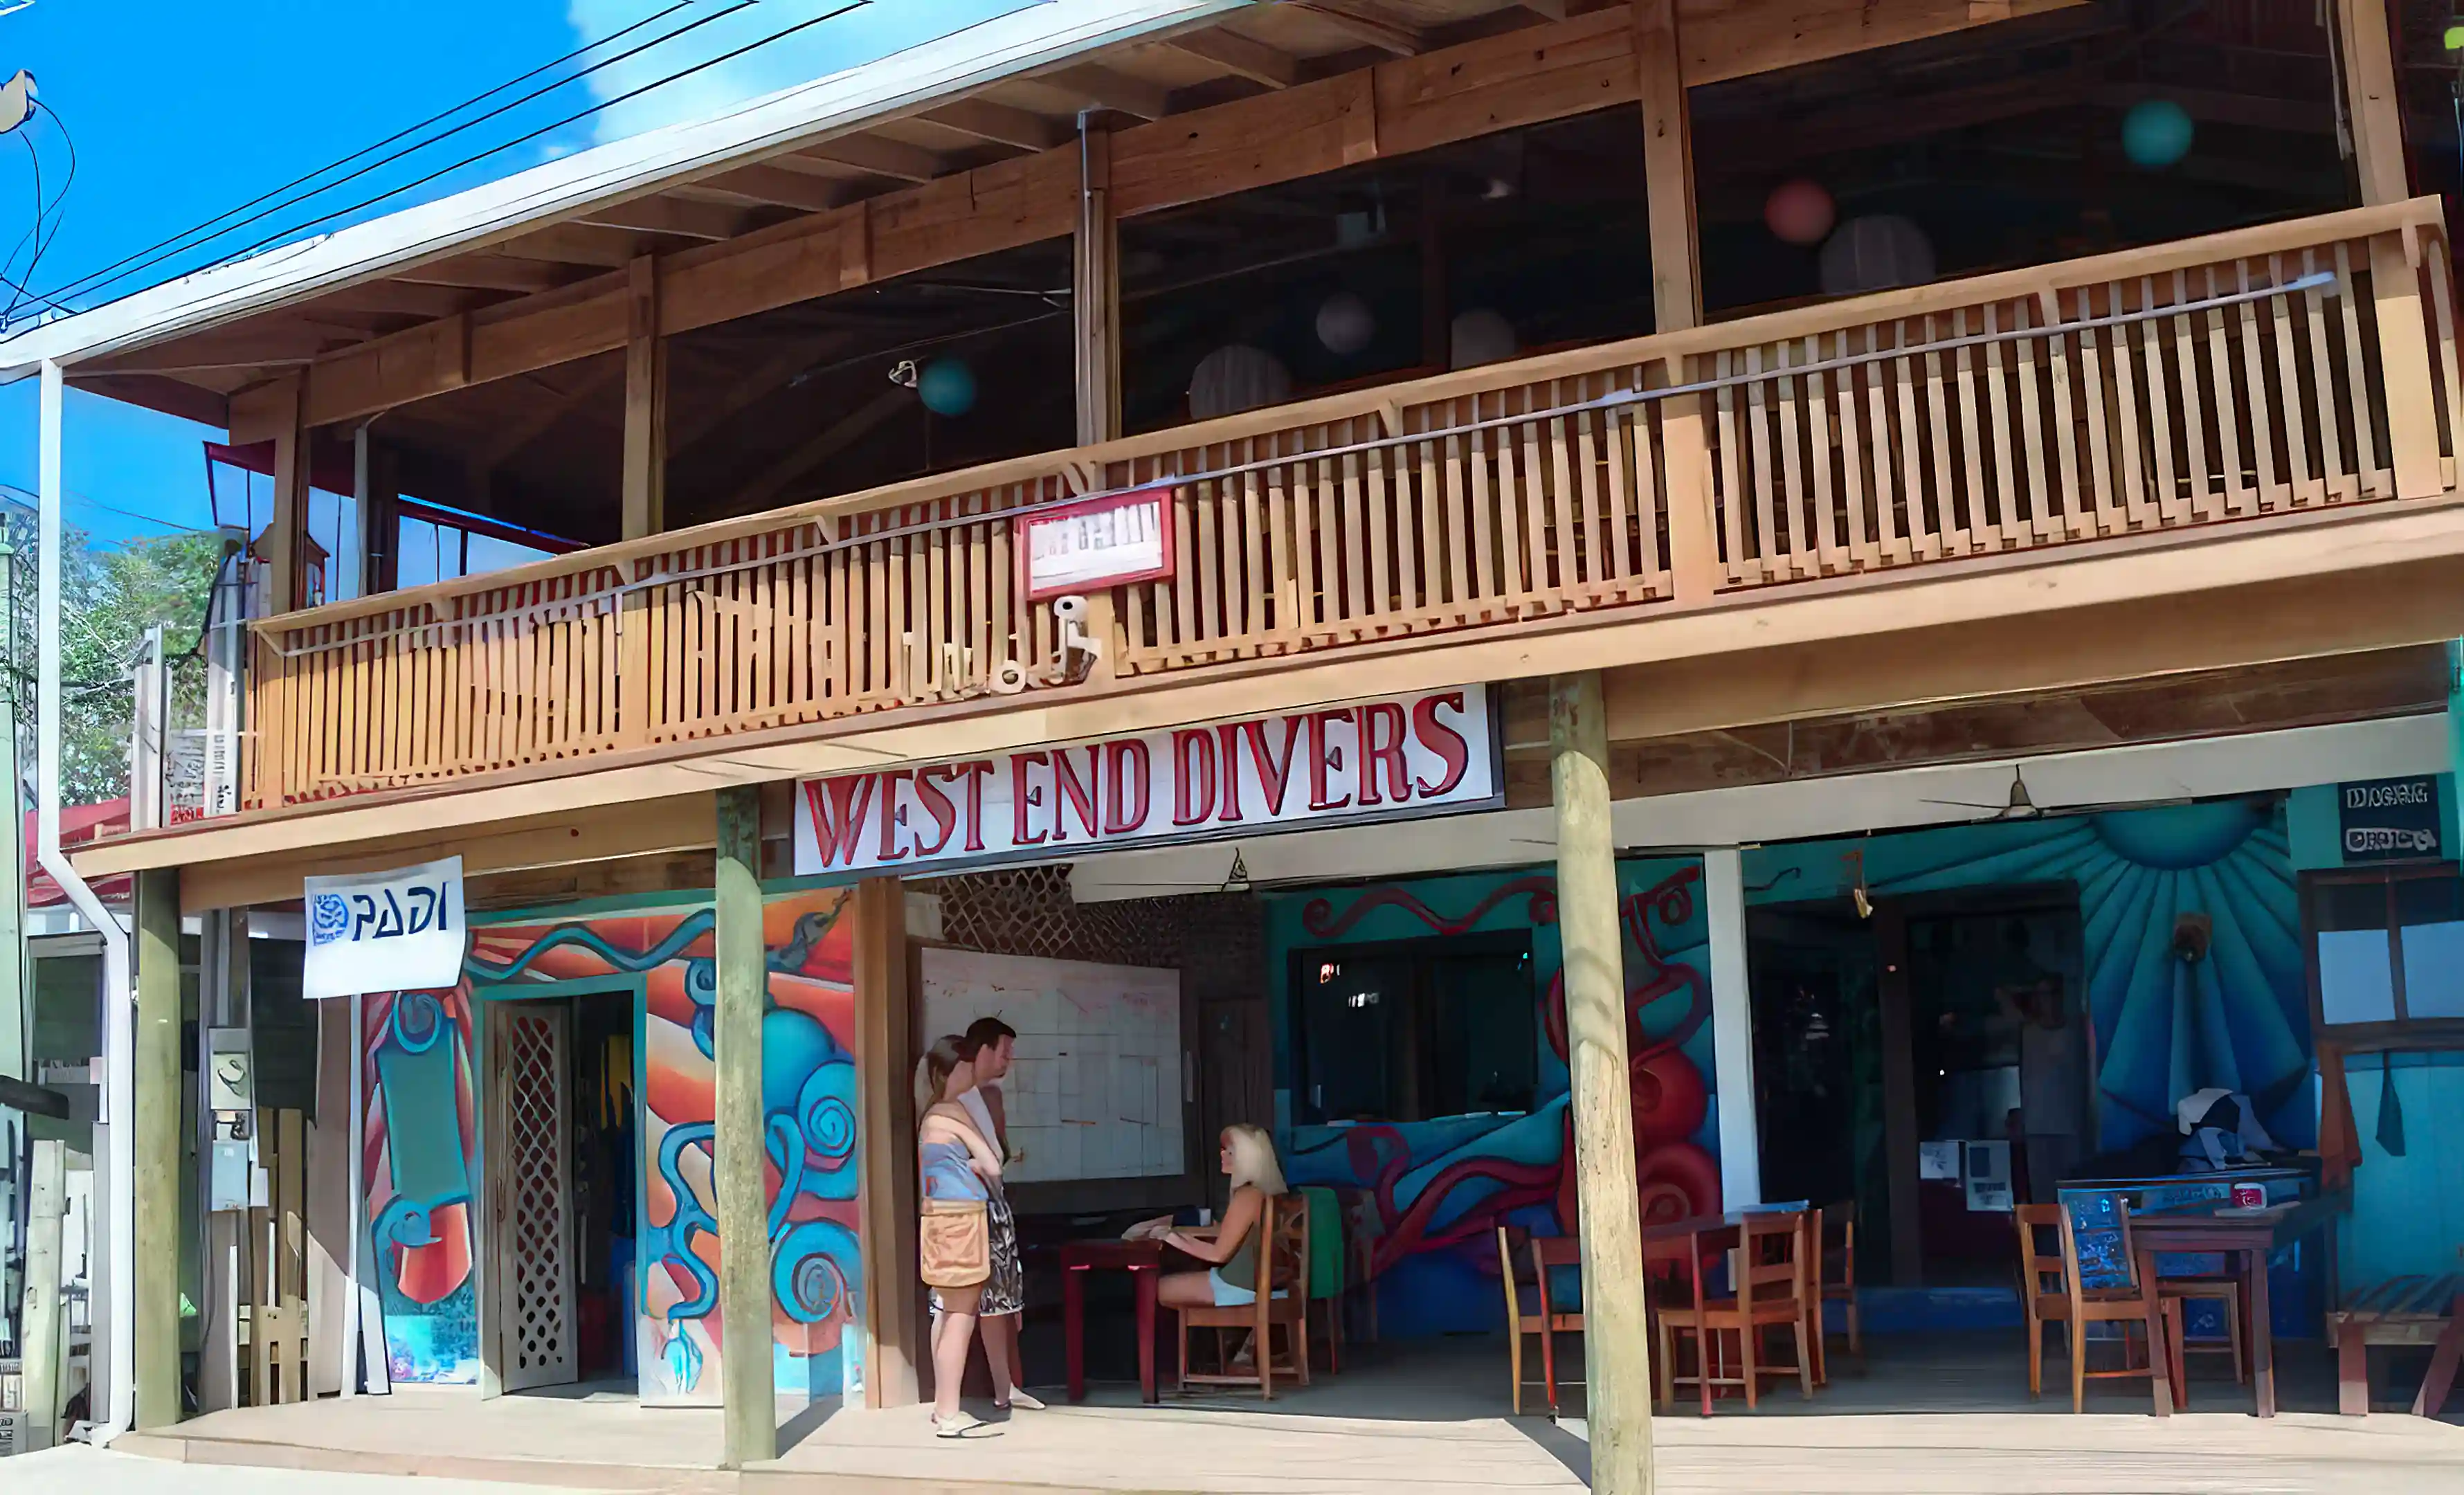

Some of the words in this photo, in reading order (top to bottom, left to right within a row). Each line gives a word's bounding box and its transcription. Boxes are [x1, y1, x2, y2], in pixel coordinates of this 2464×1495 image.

[802, 759, 995, 868] WEST
[1010, 741, 1151, 846] END
[1172, 692, 1469, 826] DIVERS
[352, 881, 449, 942] PADI
